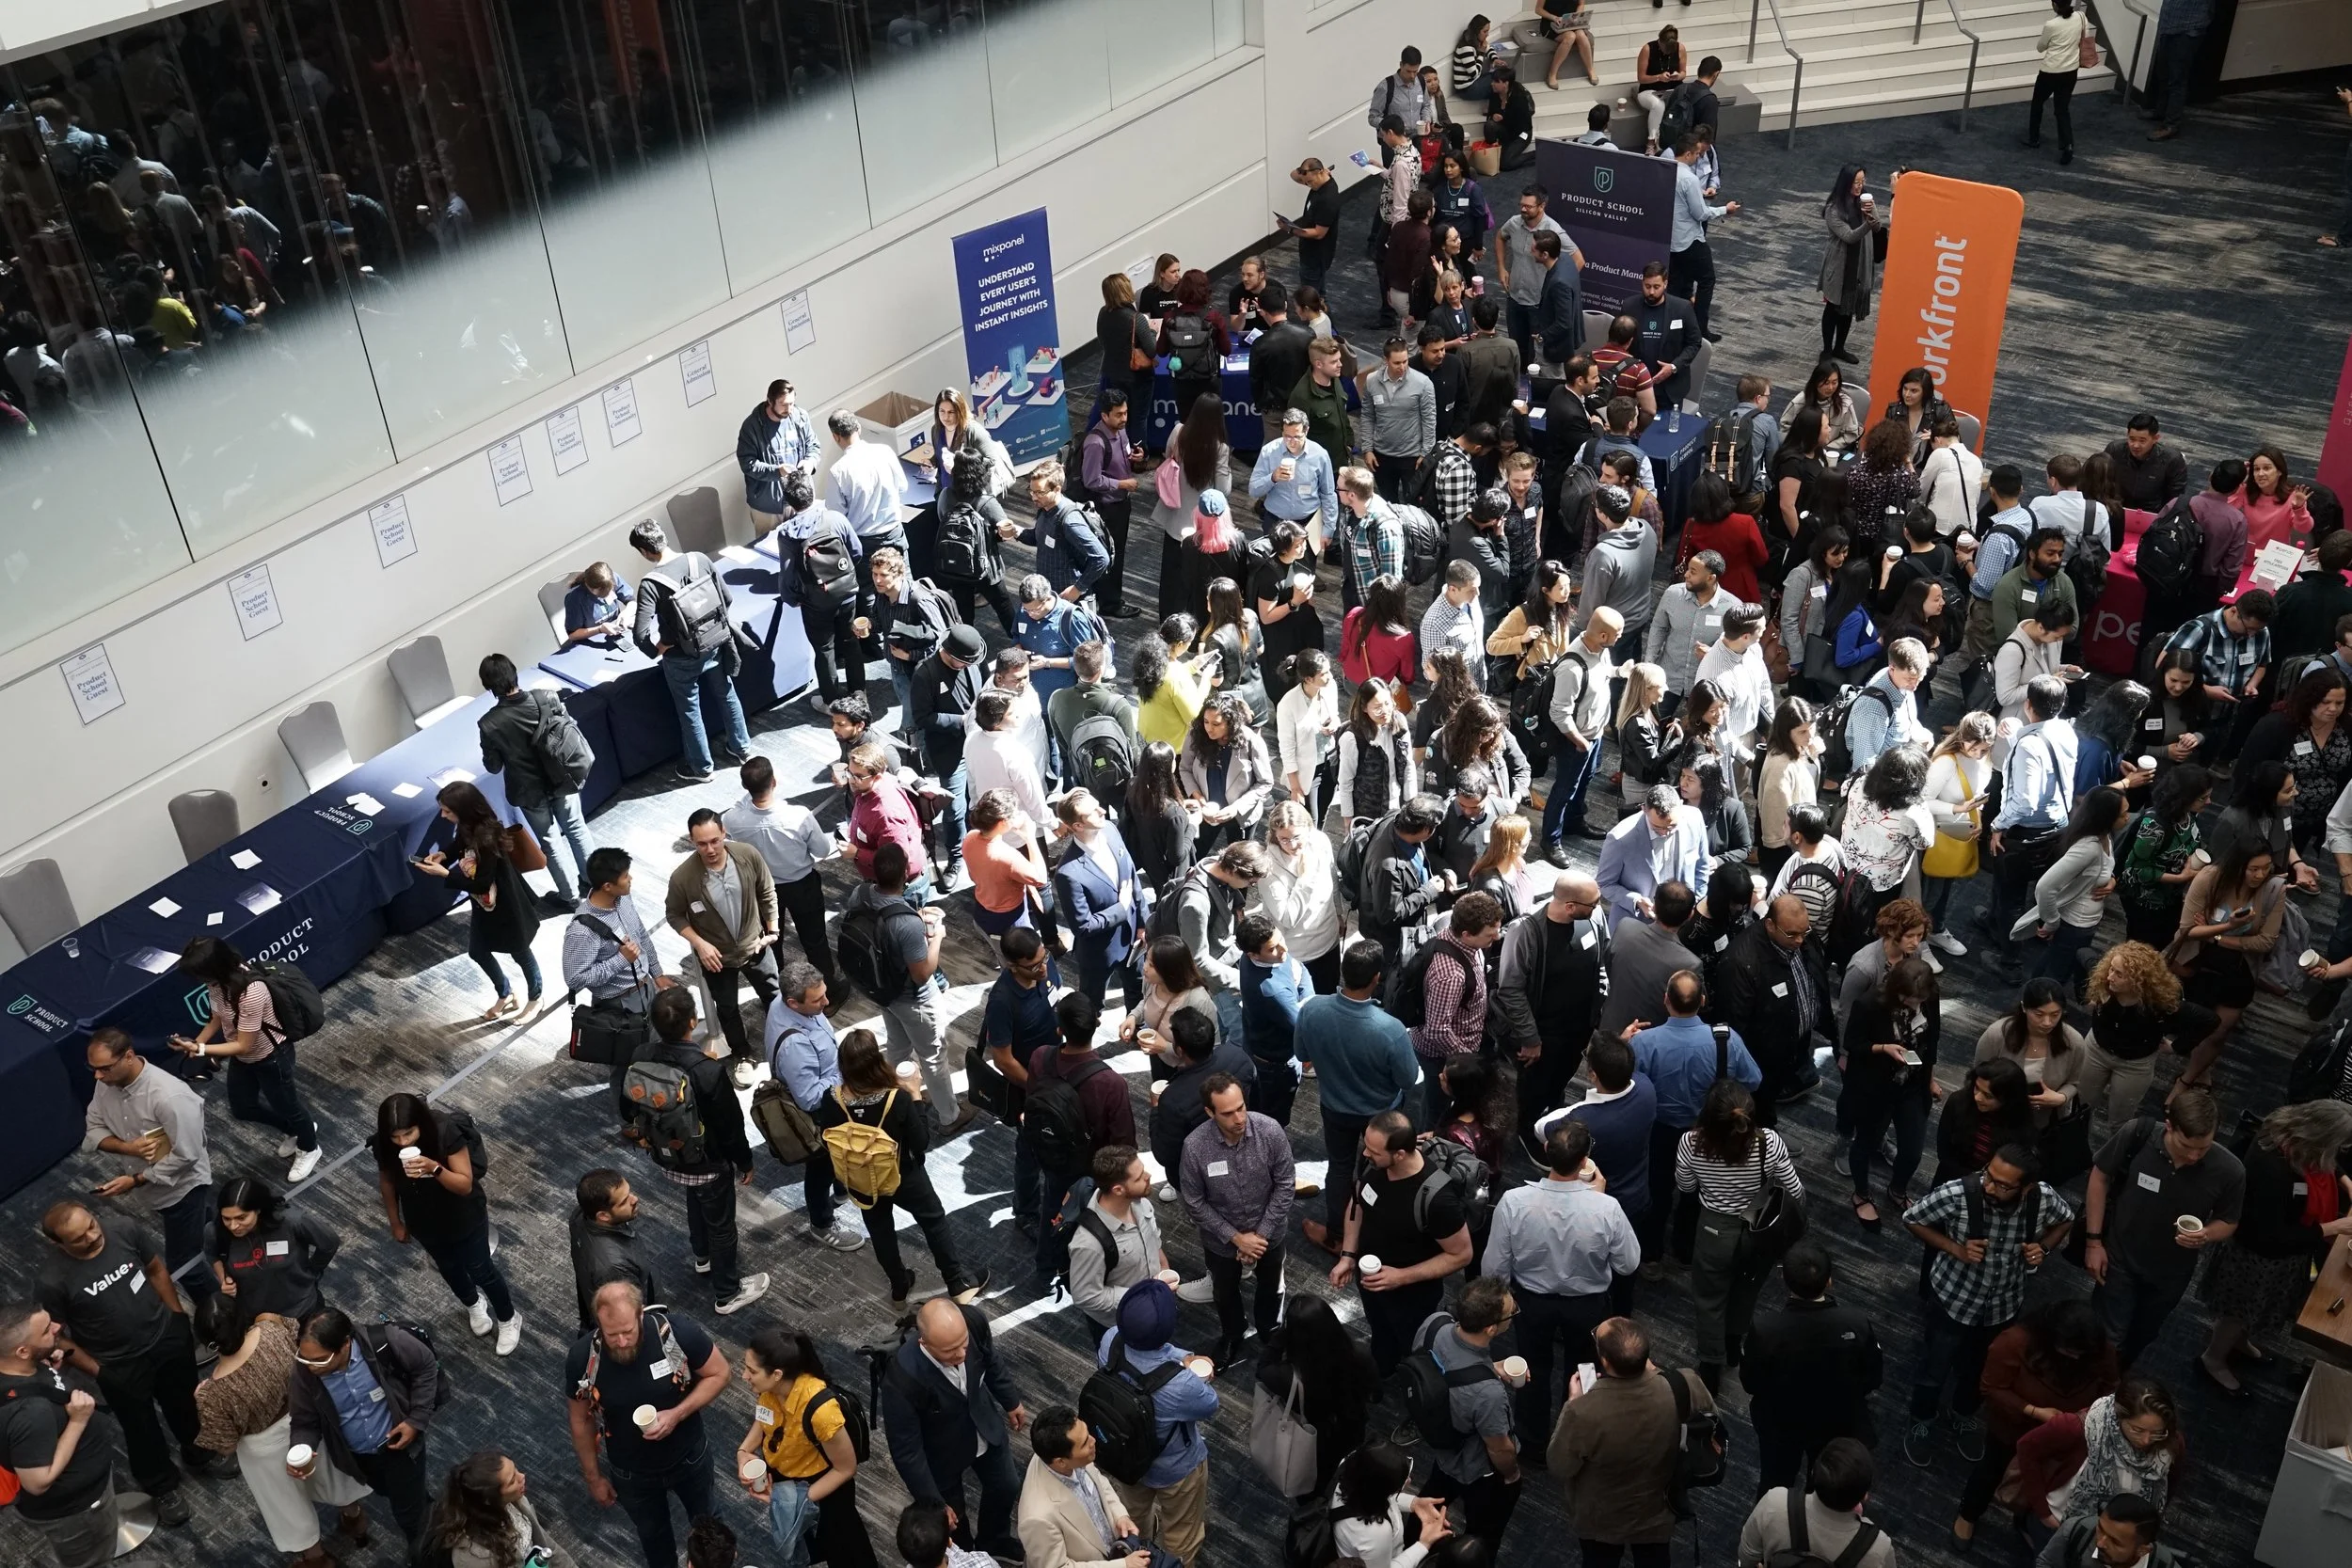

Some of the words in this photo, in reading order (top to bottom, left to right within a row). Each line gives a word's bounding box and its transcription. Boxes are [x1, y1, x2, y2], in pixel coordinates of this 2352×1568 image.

[1561, 192, 1604, 208] PRODUCT
[1607, 201, 1645, 215] SCHOOL
[1575, 207, 1601, 216] SILICON
[1604, 213, 1628, 222] VALLEY
[983, 233, 1025, 257] mixpanel
[978, 261, 1035, 288] UNDERSTAND
[1591, 261, 1620, 276] Product
[1620, 268, 1644, 280] Mana
[980, 285, 1007, 302] EVERY
[1008, 276, 1037, 292] USER'S
[979, 295, 1018, 317] JOURNEY
[1019, 288, 1041, 302] WITH
[787, 312, 807, 325] General
[975, 312, 1009, 332] INSTANT
[1010, 299, 1048, 320] INSIGHTS
[1916, 235, 1967, 401] orkfront
[787, 317, 811, 333] Admission
[686, 370, 711, 385] Admission
[687, 364, 707, 377] General
[612, 404, 630, 415] Product
[615, 409, 630, 420] School
[557, 432, 576, 443] Product
[560, 437, 576, 447] School
[555, 440, 581, 456] Community
[500, 461, 519, 473] Product
[502, 467, 519, 478] School
[380, 520, 405, 536] Product
[384, 528, 405, 541] School
[386, 534, 405, 546] Guest
[241, 590, 268, 607] Product
[245, 597, 268, 612] School
[248, 605, 269, 618] Guest
[77, 671, 107, 690] Product
[81, 679, 107, 696] School
[86, 687, 109, 701] Guest
[314, 810, 348, 826] PRODUCT
[327, 806, 356, 820] SCHOOL
[246, 917, 314, 965] RODUCT
[277, 943, 310, 964] OOL
[24, 1013, 52, 1033] SCHOOL
[34, 1006, 69, 1029] PRODUCT
